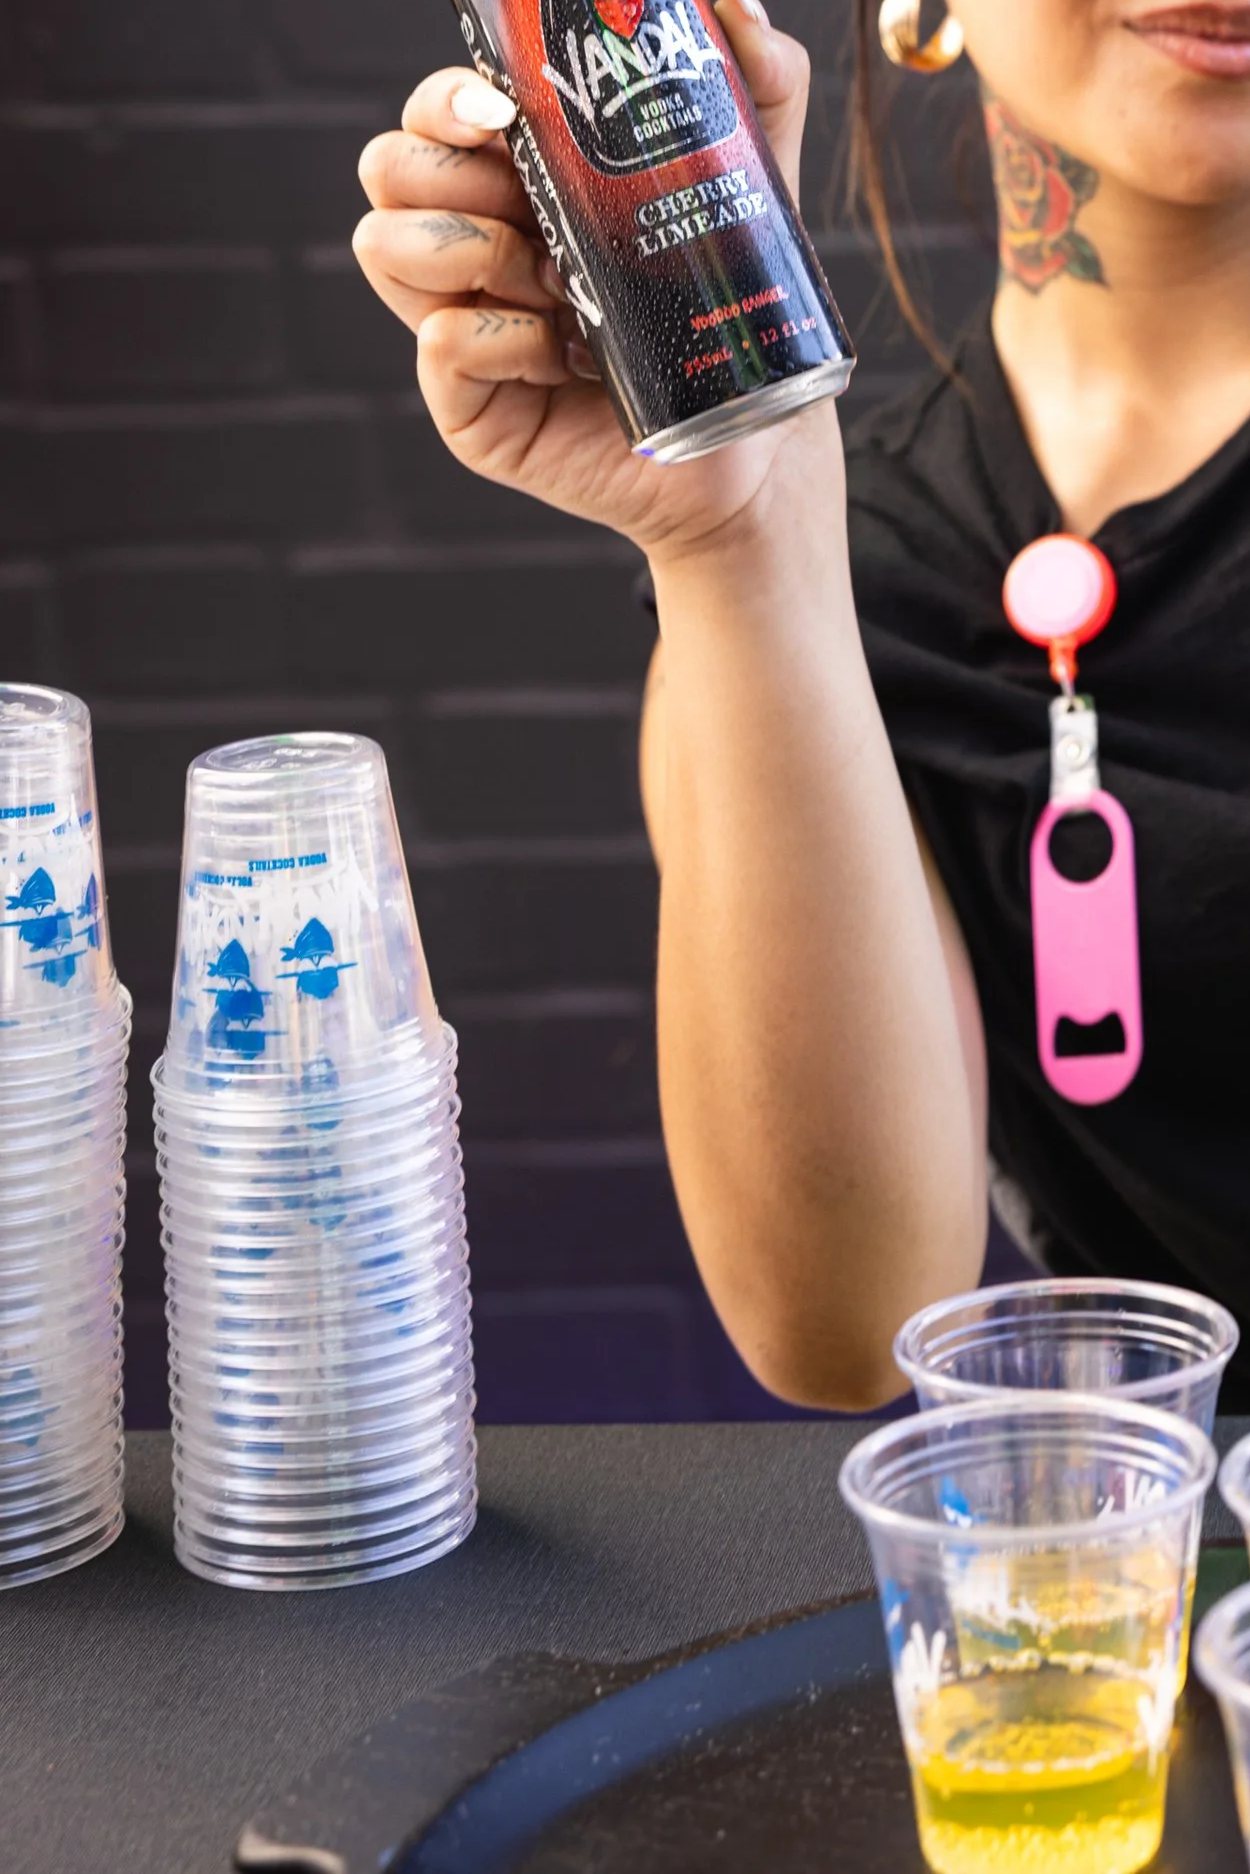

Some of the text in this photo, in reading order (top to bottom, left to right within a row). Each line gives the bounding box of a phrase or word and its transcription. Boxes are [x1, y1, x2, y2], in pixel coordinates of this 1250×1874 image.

[542, 1, 726, 134] VANDAL
[633, 105, 702, 142] COCKTAILS
[639, 93, 684, 121] VODKA
[636, 169, 748, 227] CHERRY
[634, 192, 768, 257] LIMEADE
[690, 284, 789, 332] VOODOO RANGER
[760, 327, 779, 346] 12
[298, 852, 327, 868] VODKA
